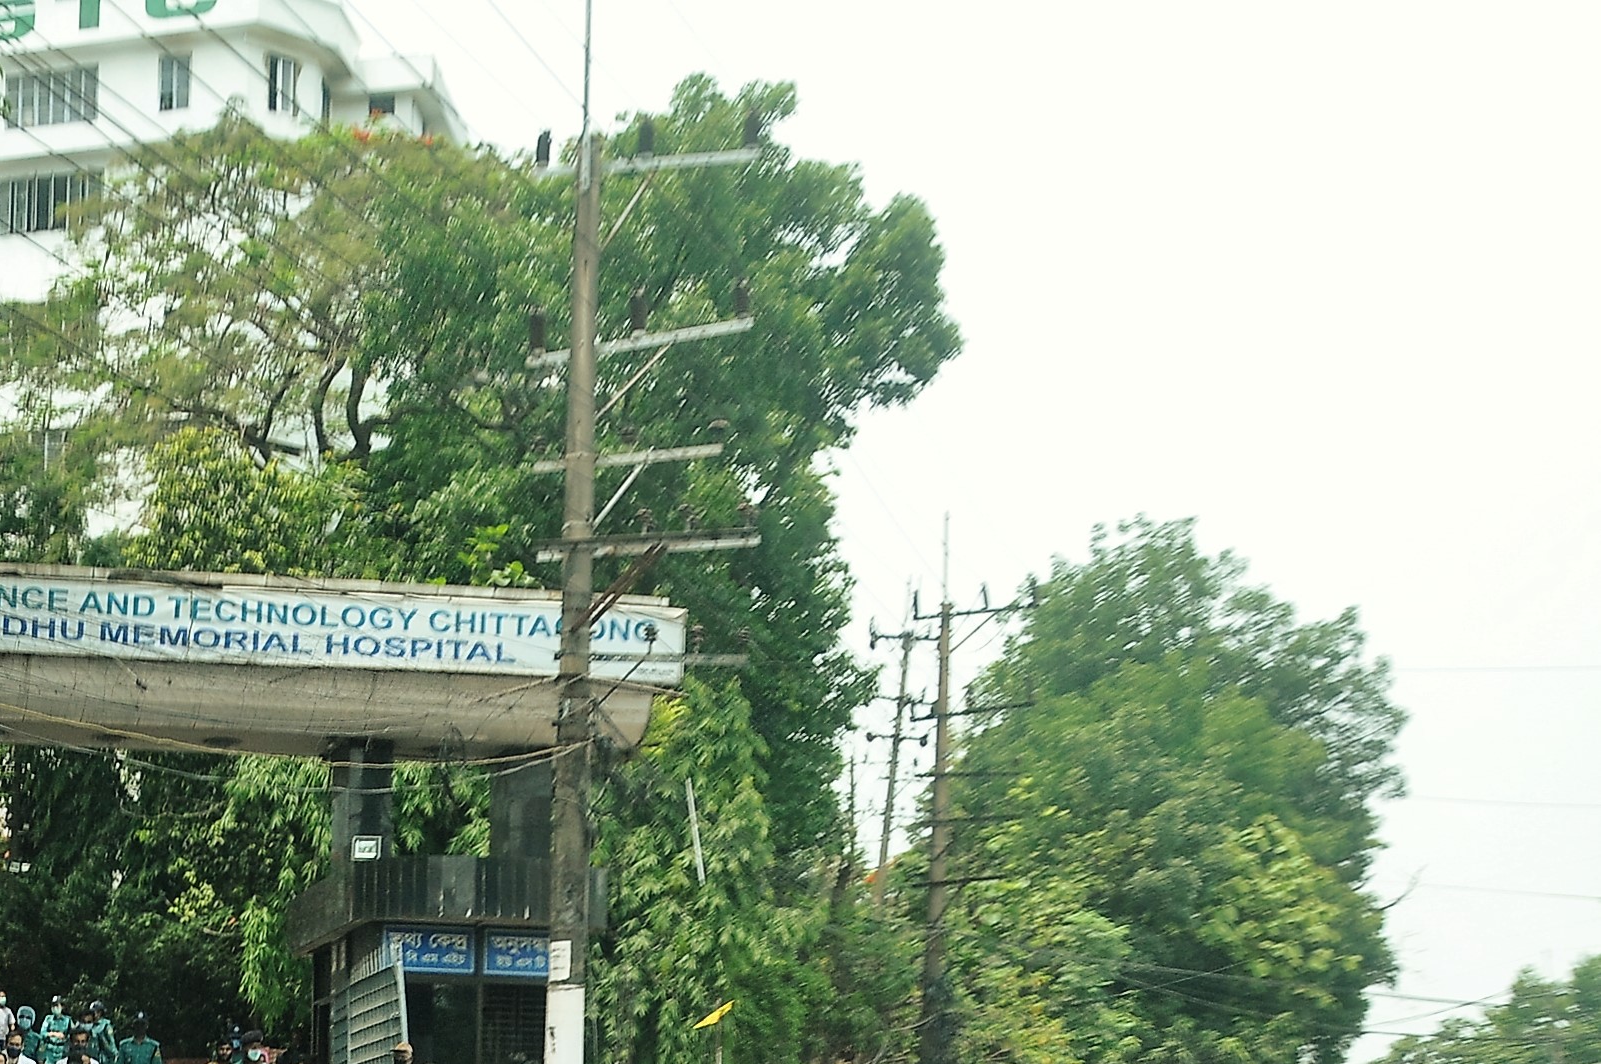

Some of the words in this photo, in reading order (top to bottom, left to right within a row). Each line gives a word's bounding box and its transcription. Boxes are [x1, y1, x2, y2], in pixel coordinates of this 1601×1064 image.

[79, 590, 155, 618] AND
[168, 594, 419, 633] TECHNOLOGY
[100, 621, 313, 656] MEMORIAL
[325, 633, 517, 664] HOSPITAL
